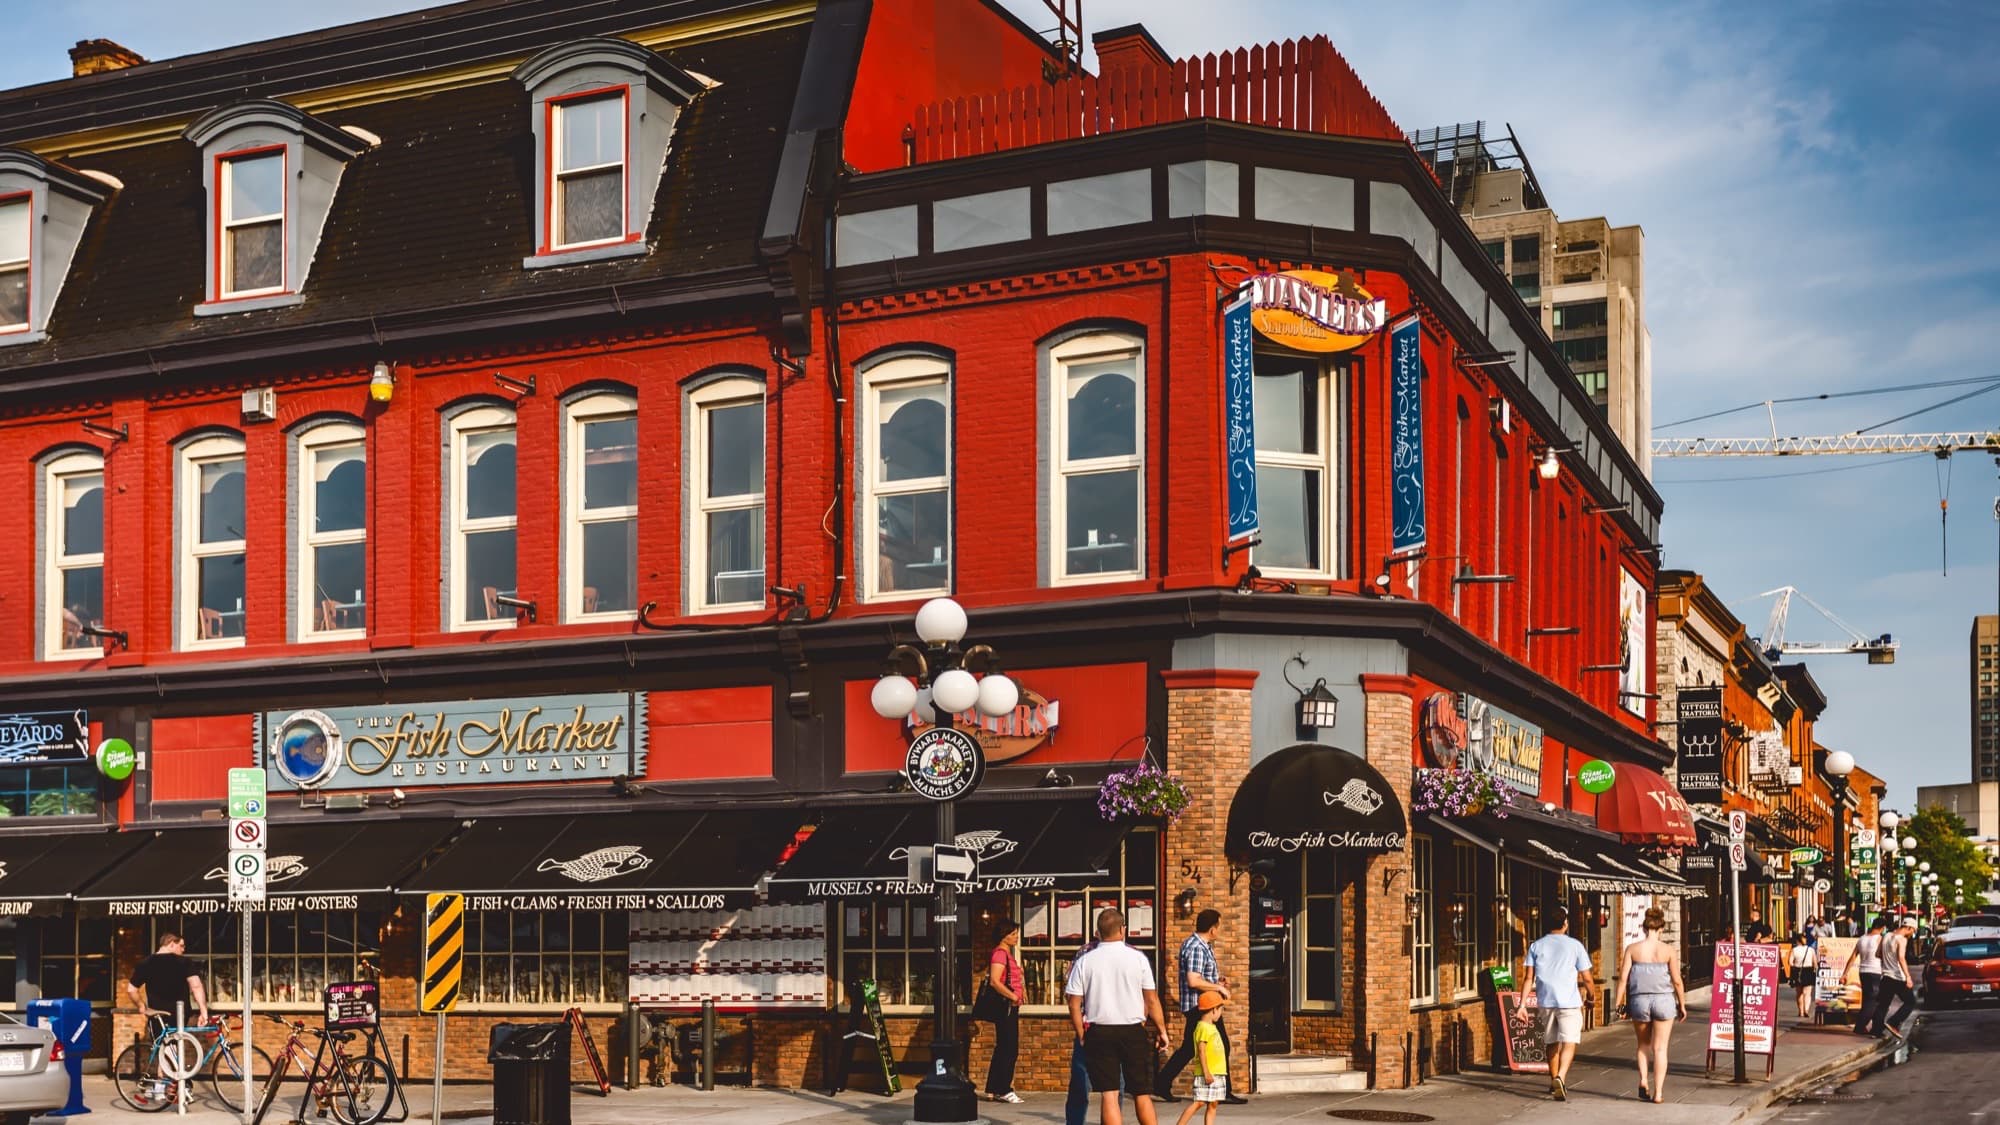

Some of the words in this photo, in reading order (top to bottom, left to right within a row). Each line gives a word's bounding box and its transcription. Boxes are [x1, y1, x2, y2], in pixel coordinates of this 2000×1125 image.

[1231, 318, 1243, 399] Market
[1243, 317, 1252, 447] RESTAURANT
[1397, 337, 1409, 415] Market
[1410, 336, 1419, 464] RESTAURANT
[356, 715, 393, 729] THE
[1681, 710, 1720, 718] TRATTORIA
[346, 711, 451, 775] Fish
[457, 704, 624, 757] Market
[910, 732, 939, 765] BYWARD
[942, 732, 973, 762] MARKET
[392, 755, 610, 776] RESTAURANT
[954, 776, 966, 790] BY
[1248, 831, 1280, 848] The
[1280, 832, 1327, 853] Fish
[1328, 832, 1384, 848] Market
[241, 859, 253, 872] P
[807, 881, 873, 896] MUSSELS
[885, 881, 935, 895] FRESH
[986, 876, 1055, 892] LOBSTER
[109, 902, 145, 916] FRESH
[149, 901, 174, 915] FISH
[181, 900, 218, 915] SQUID
[227, 899, 266, 913] FRSH
[269, 897, 296, 912] FISH
[305, 895, 358, 910] OYSTERS
[473, 896, 501, 911] FISH
[511, 896, 557, 910] CLAMS
[567, 895, 612, 910] FRESH
[616, 894, 647, 909] FISH
[656, 894, 725, 909] SCALLOPS
[1720, 946, 1776, 959] VIEYARDS
[1511, 1036, 1535, 1052] FISH
